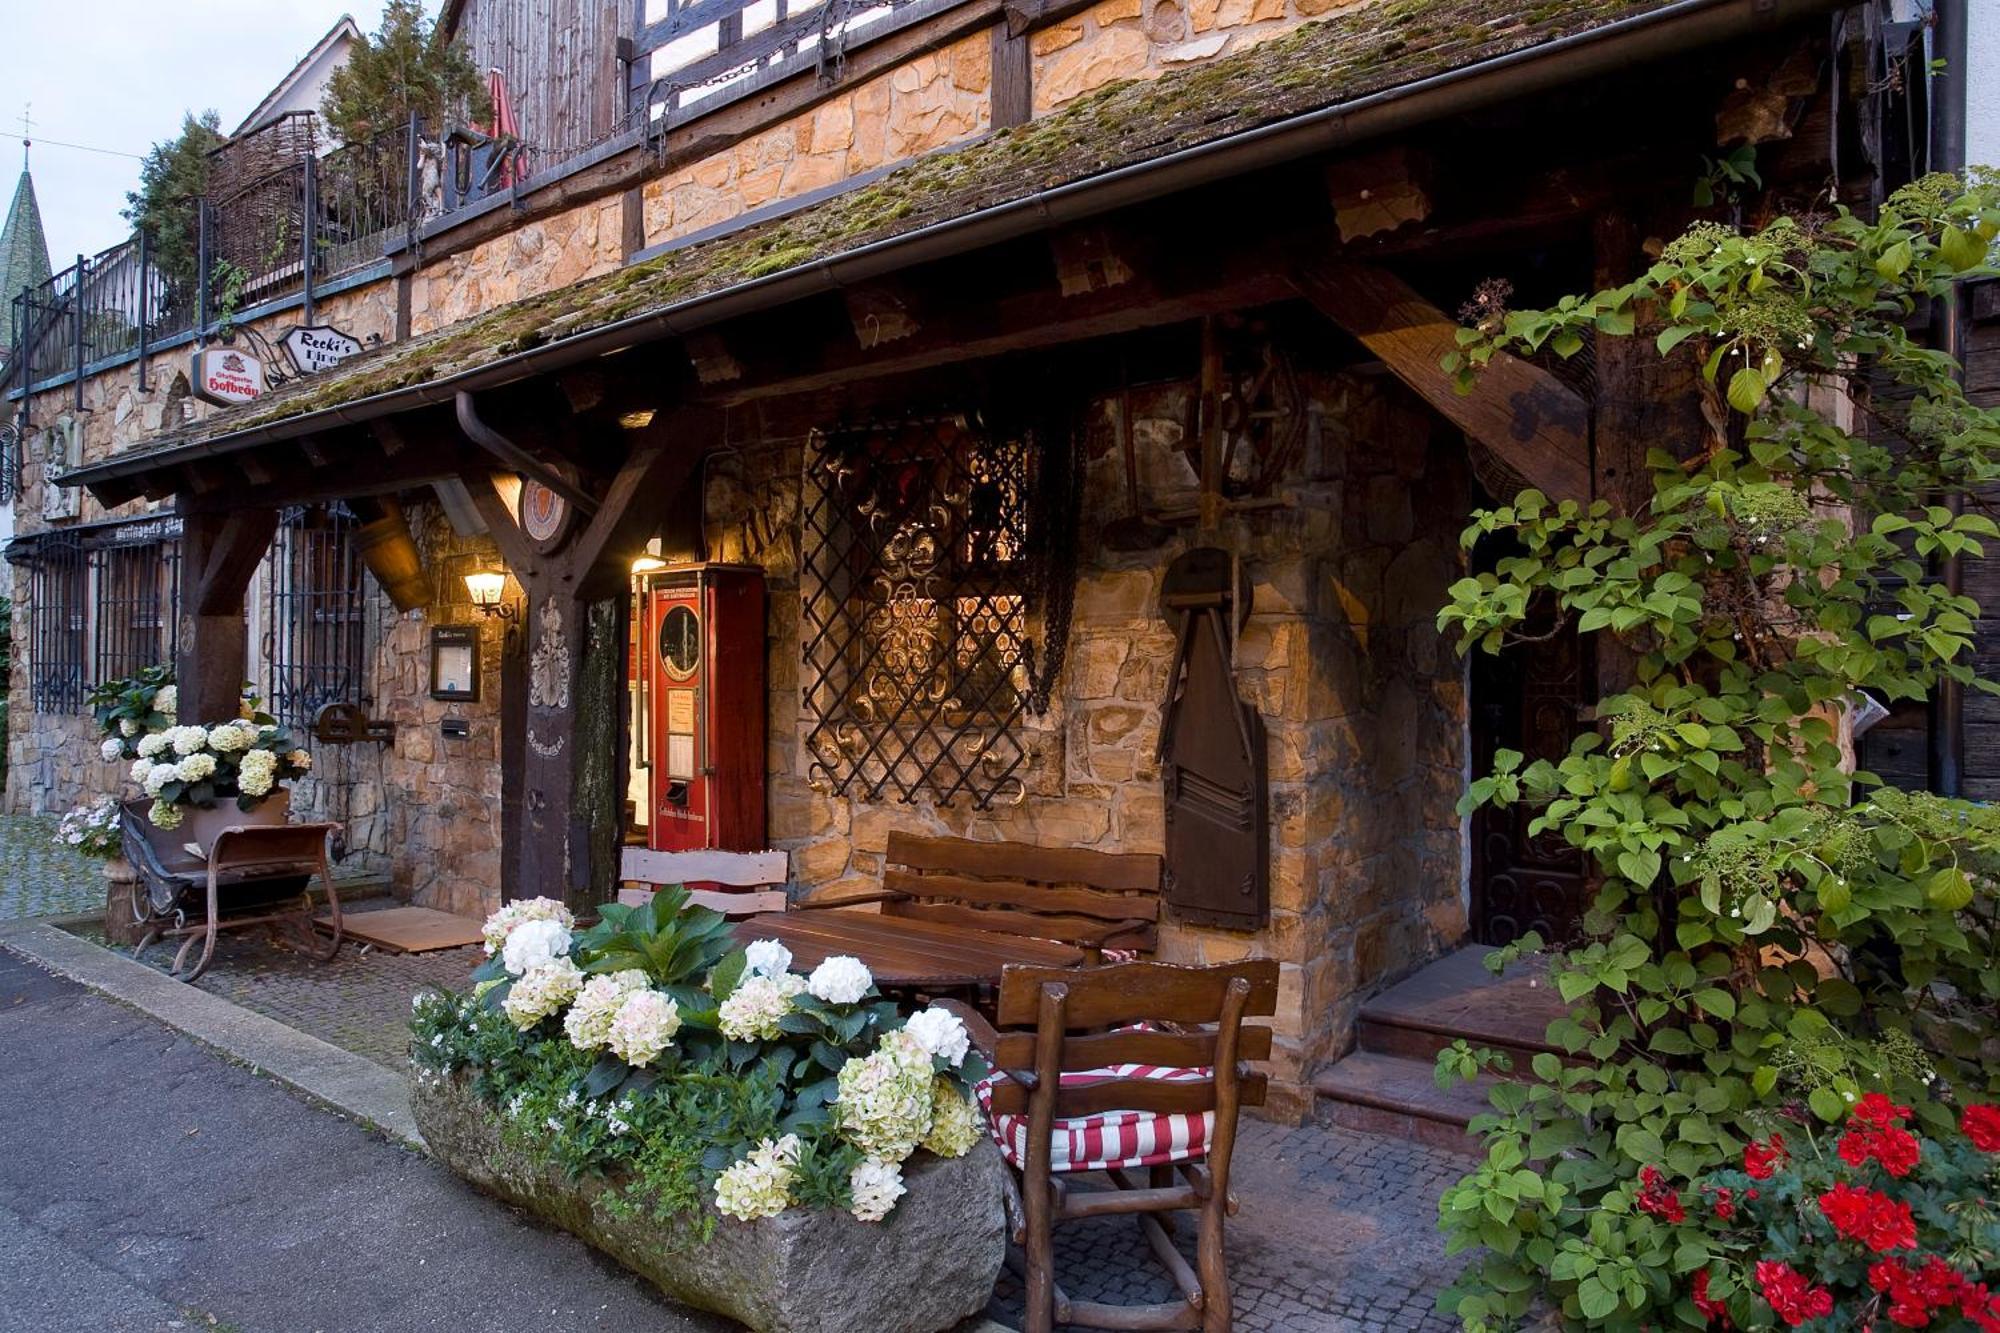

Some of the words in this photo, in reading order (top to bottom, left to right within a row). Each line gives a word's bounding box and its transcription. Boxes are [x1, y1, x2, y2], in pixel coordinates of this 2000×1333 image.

[301, 331, 351, 354] Recki's
[306, 349, 340, 365] Dine
[209, 377, 259, 397] Hofbräu
